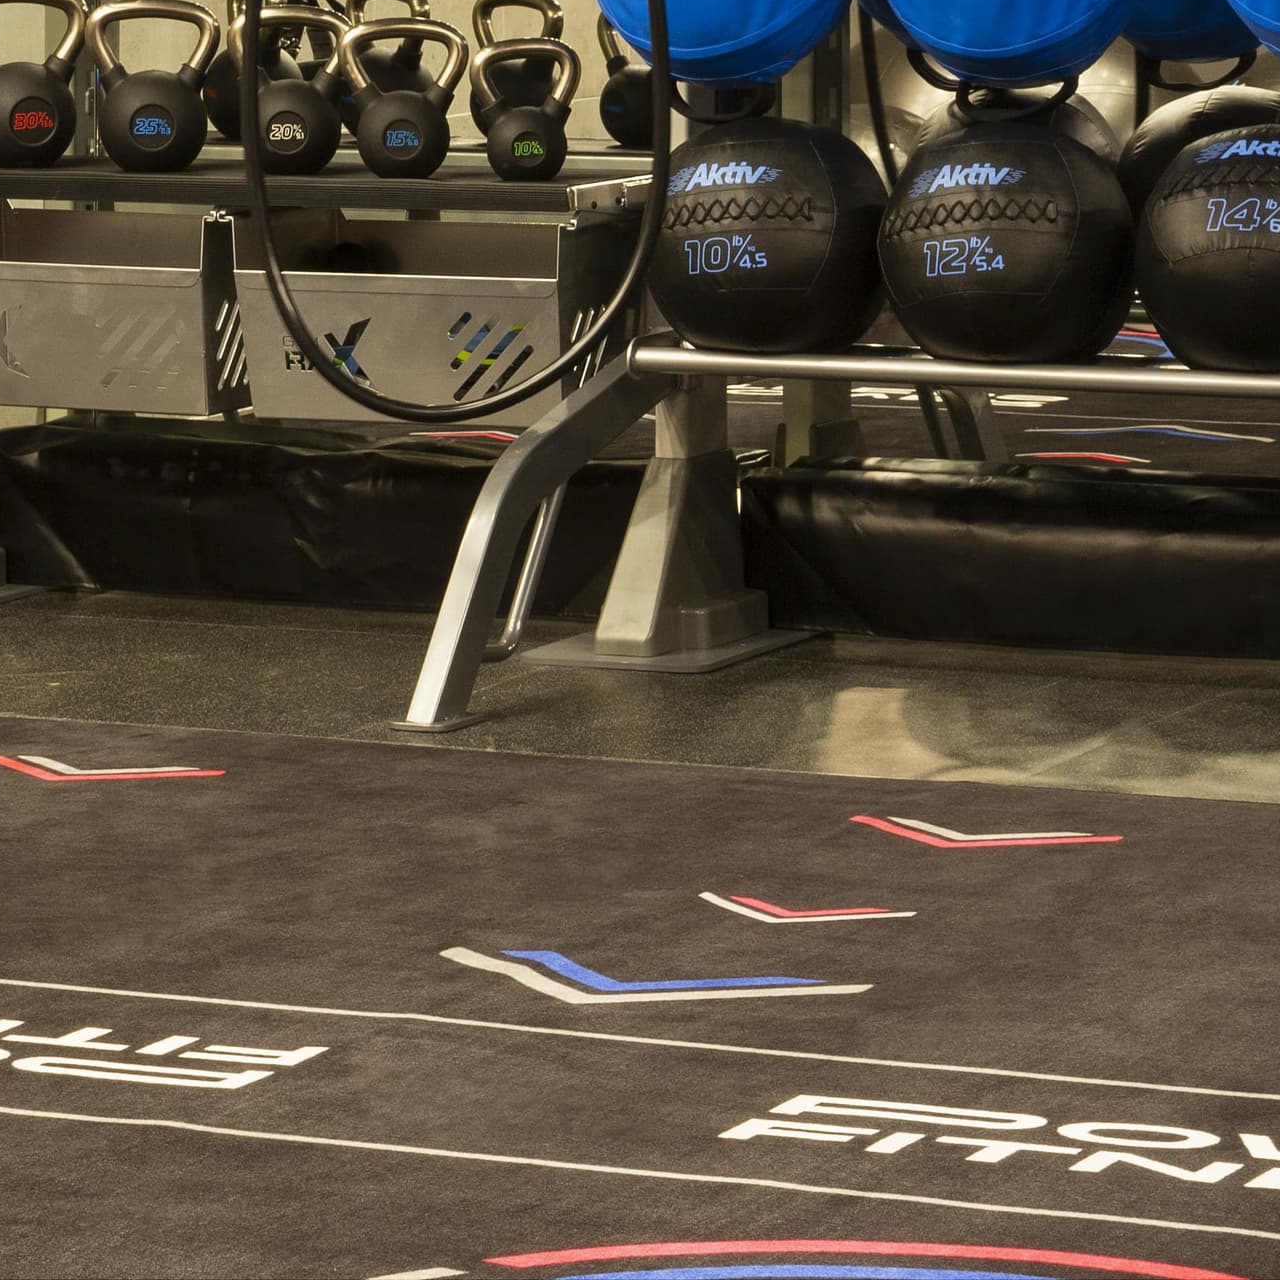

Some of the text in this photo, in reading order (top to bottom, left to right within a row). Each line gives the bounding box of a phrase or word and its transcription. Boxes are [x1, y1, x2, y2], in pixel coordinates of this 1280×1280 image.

[685, 160, 768, 192] Aktiv
[928, 162, 1011, 193] Aktiv
[1206, 197, 1261, 232] 14
[684, 237, 731, 275] 10
[923, 238, 969, 278] 12
